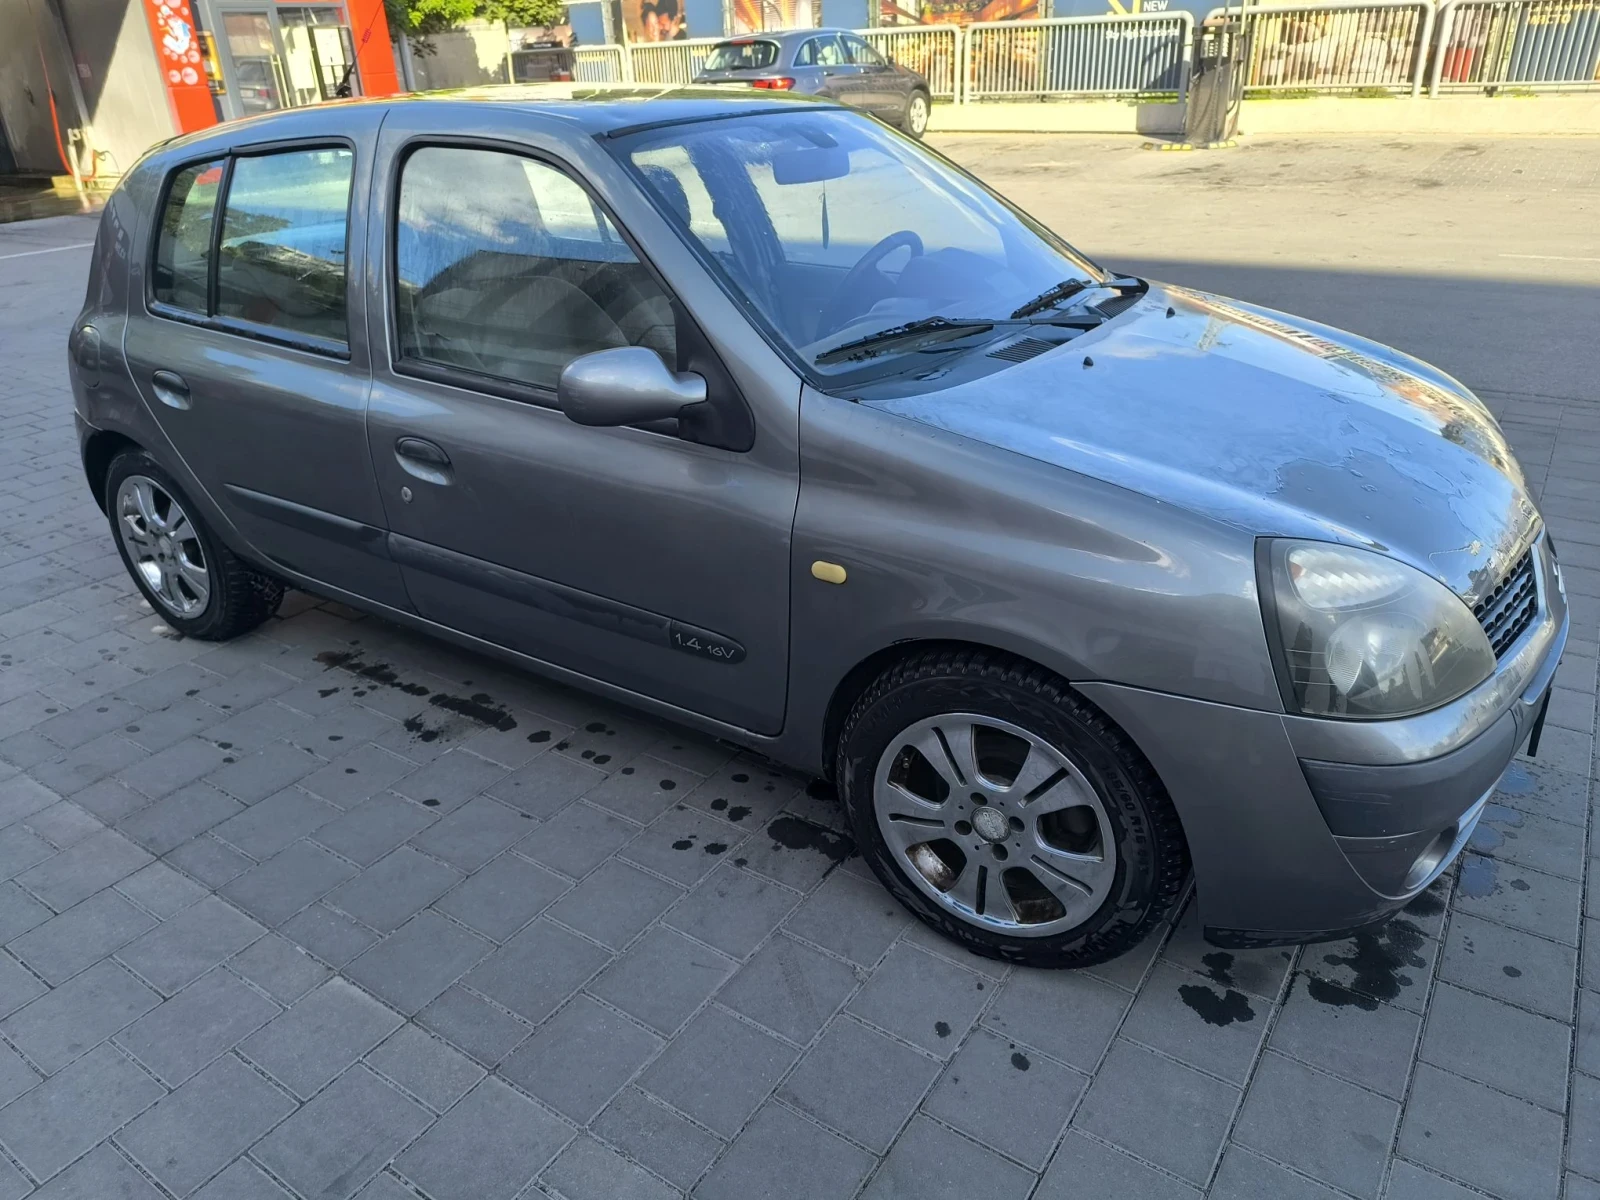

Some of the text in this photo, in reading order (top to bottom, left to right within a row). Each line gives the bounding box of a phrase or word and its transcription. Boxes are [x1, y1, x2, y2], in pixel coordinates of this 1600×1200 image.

[1143, 0, 1169, 12] NEW
[675, 633, 735, 660] 1.4 16V
